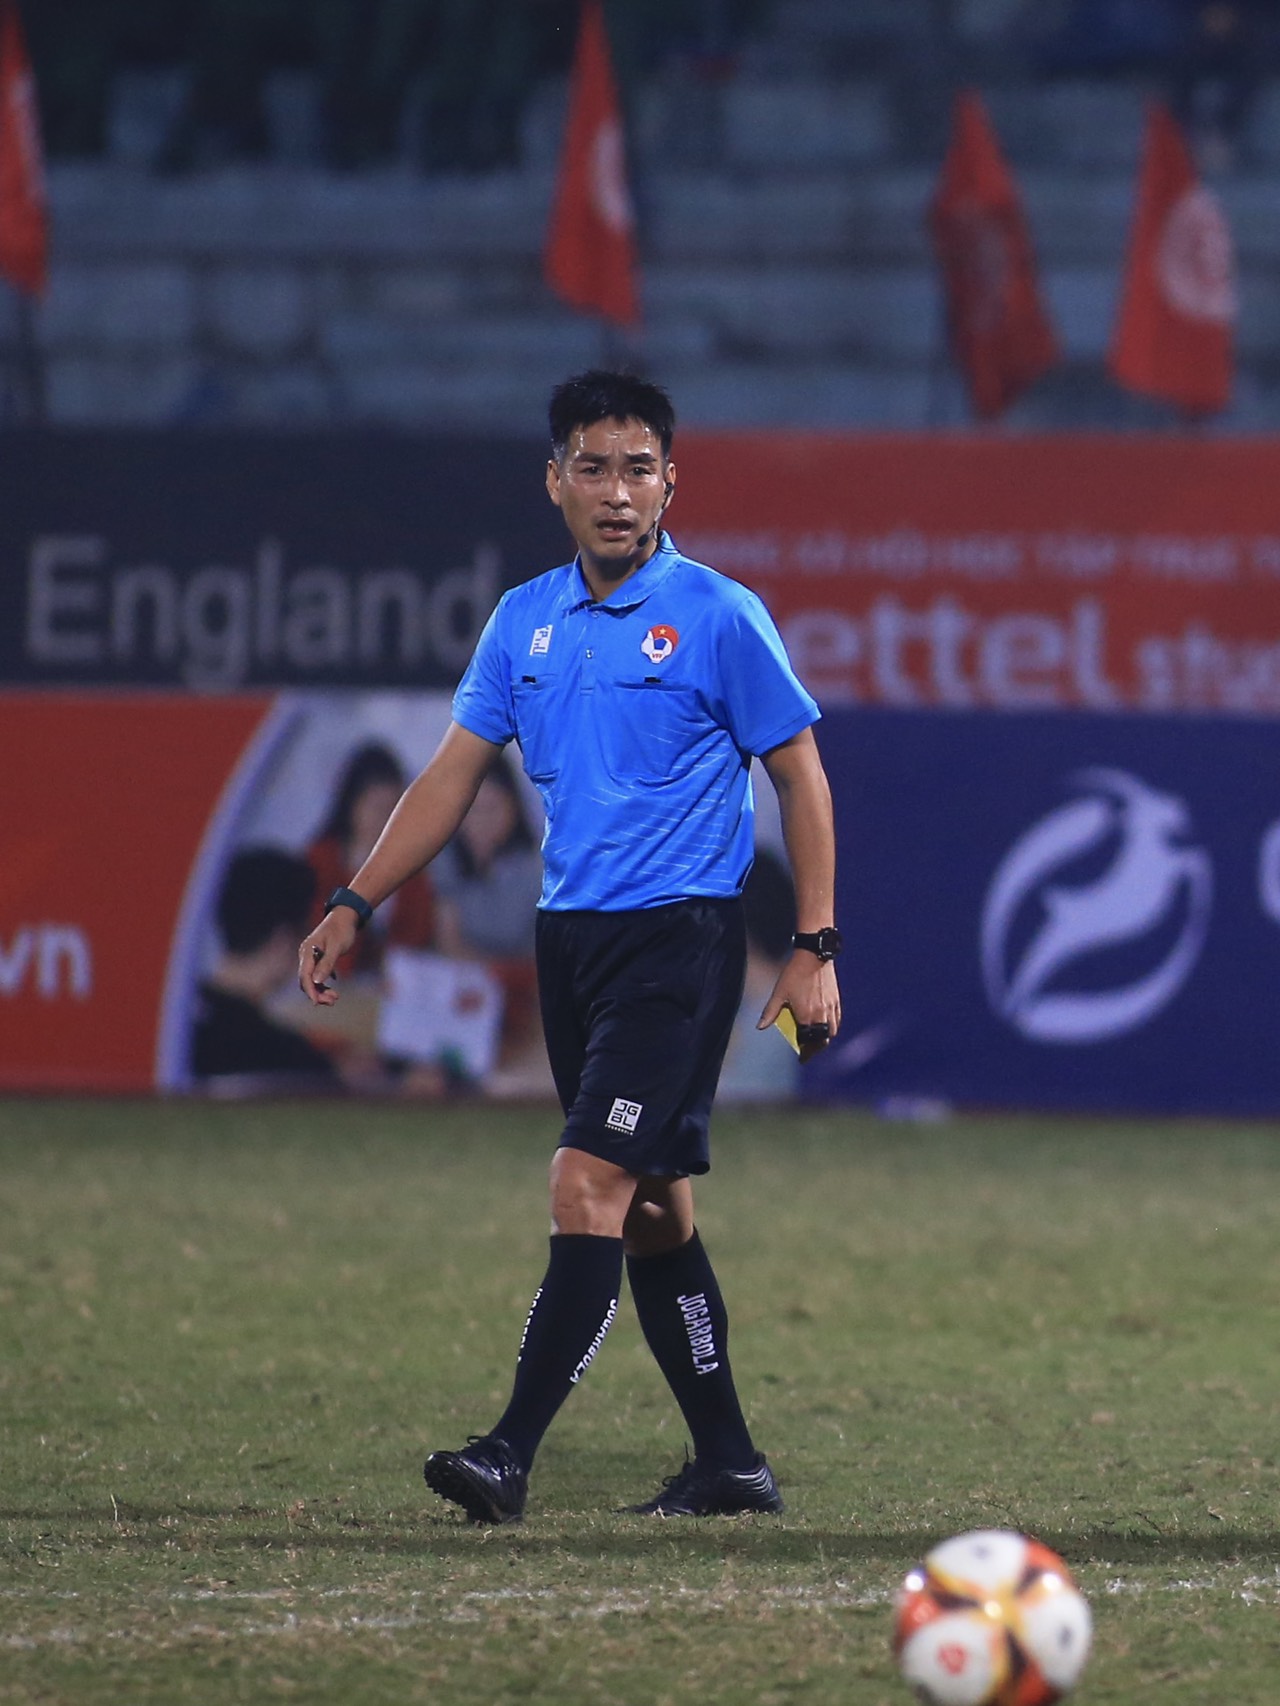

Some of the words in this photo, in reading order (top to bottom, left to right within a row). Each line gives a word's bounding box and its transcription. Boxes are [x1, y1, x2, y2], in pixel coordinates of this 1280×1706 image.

[22, 532, 500, 692] England
[780, 594, 1130, 714] ettel
[676, 1292, 720, 1376] JOGARBOLA
